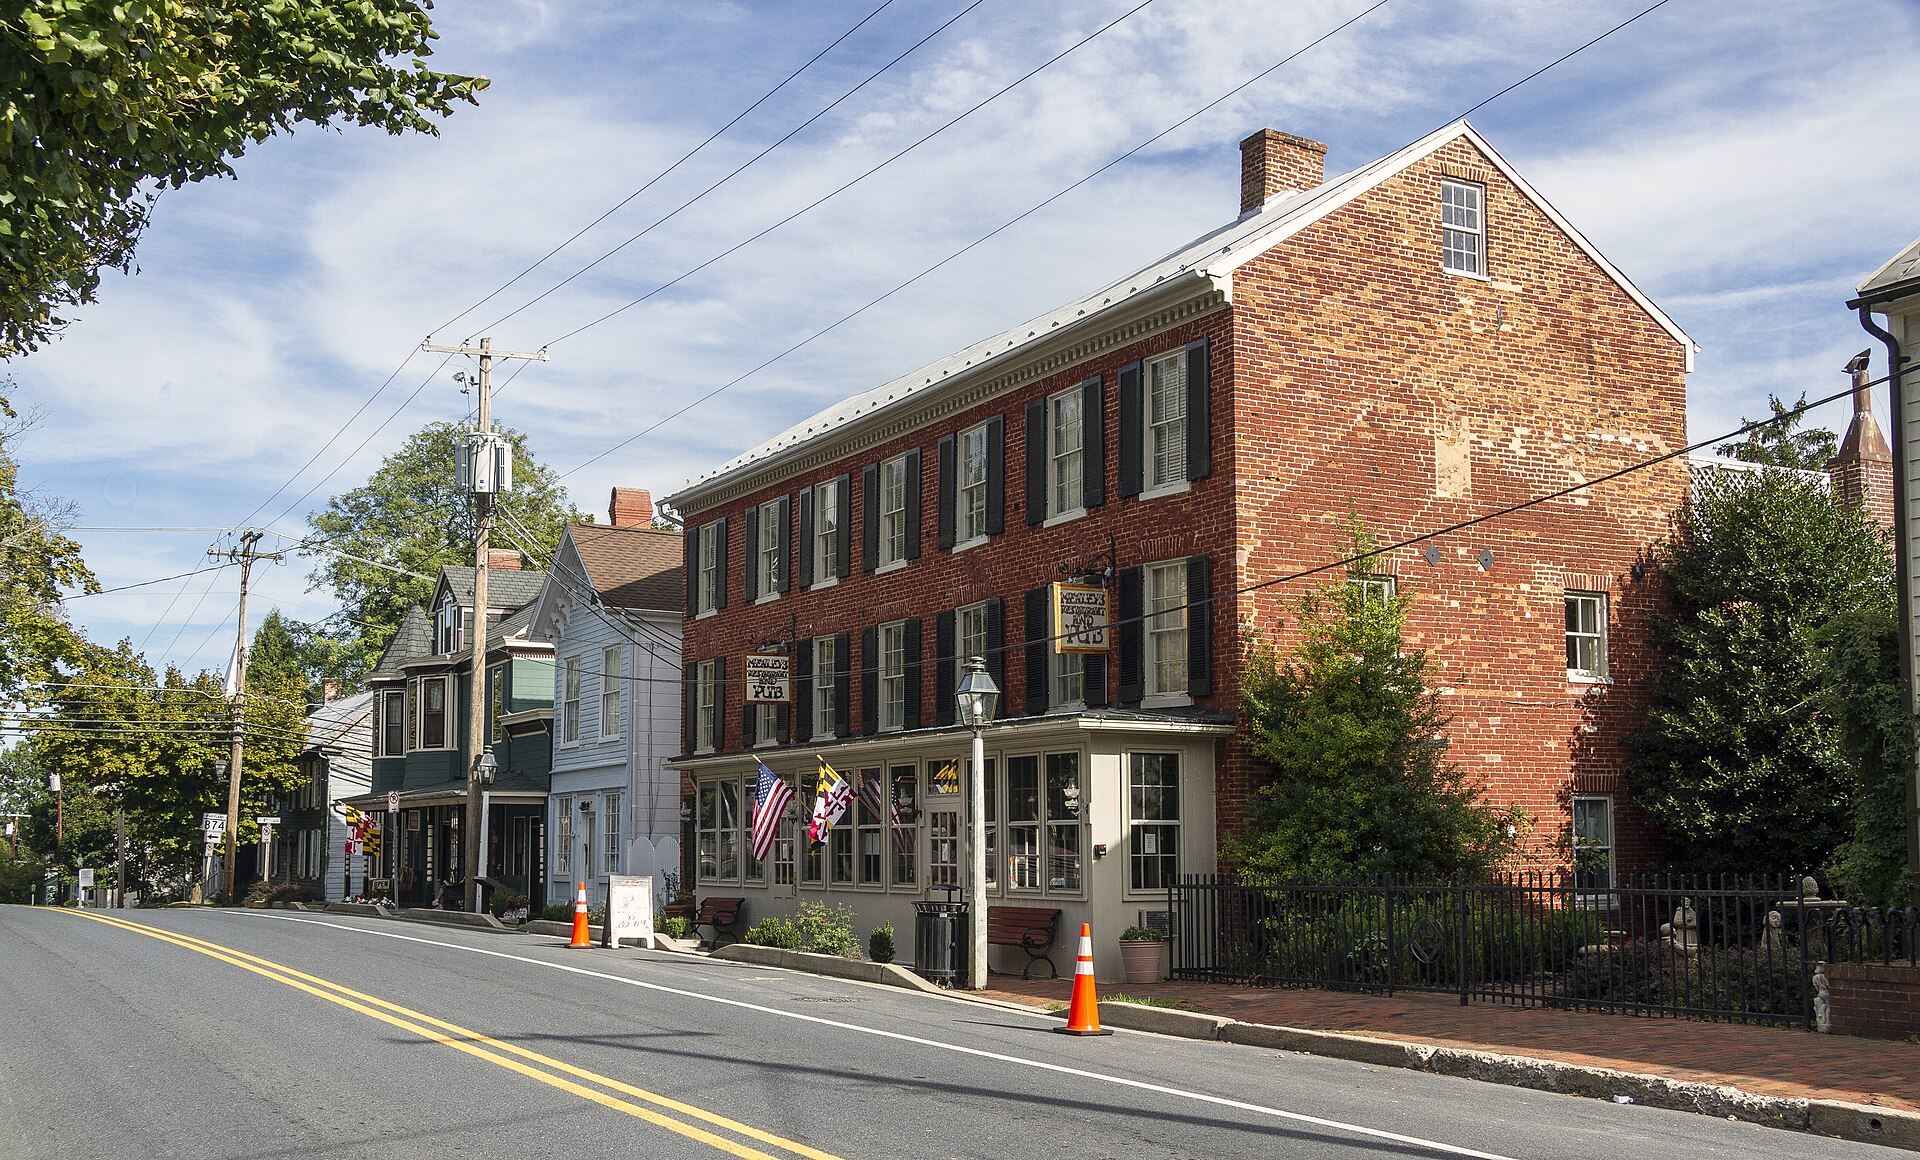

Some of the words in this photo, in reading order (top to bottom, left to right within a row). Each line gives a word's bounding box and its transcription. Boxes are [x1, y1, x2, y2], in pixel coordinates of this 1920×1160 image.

[1060, 604, 1106, 616] RESTAURANT
[1072, 613, 1094, 627] AND
[204, 820, 225, 831] 874
[374, 880, 389, 888] OPEN
